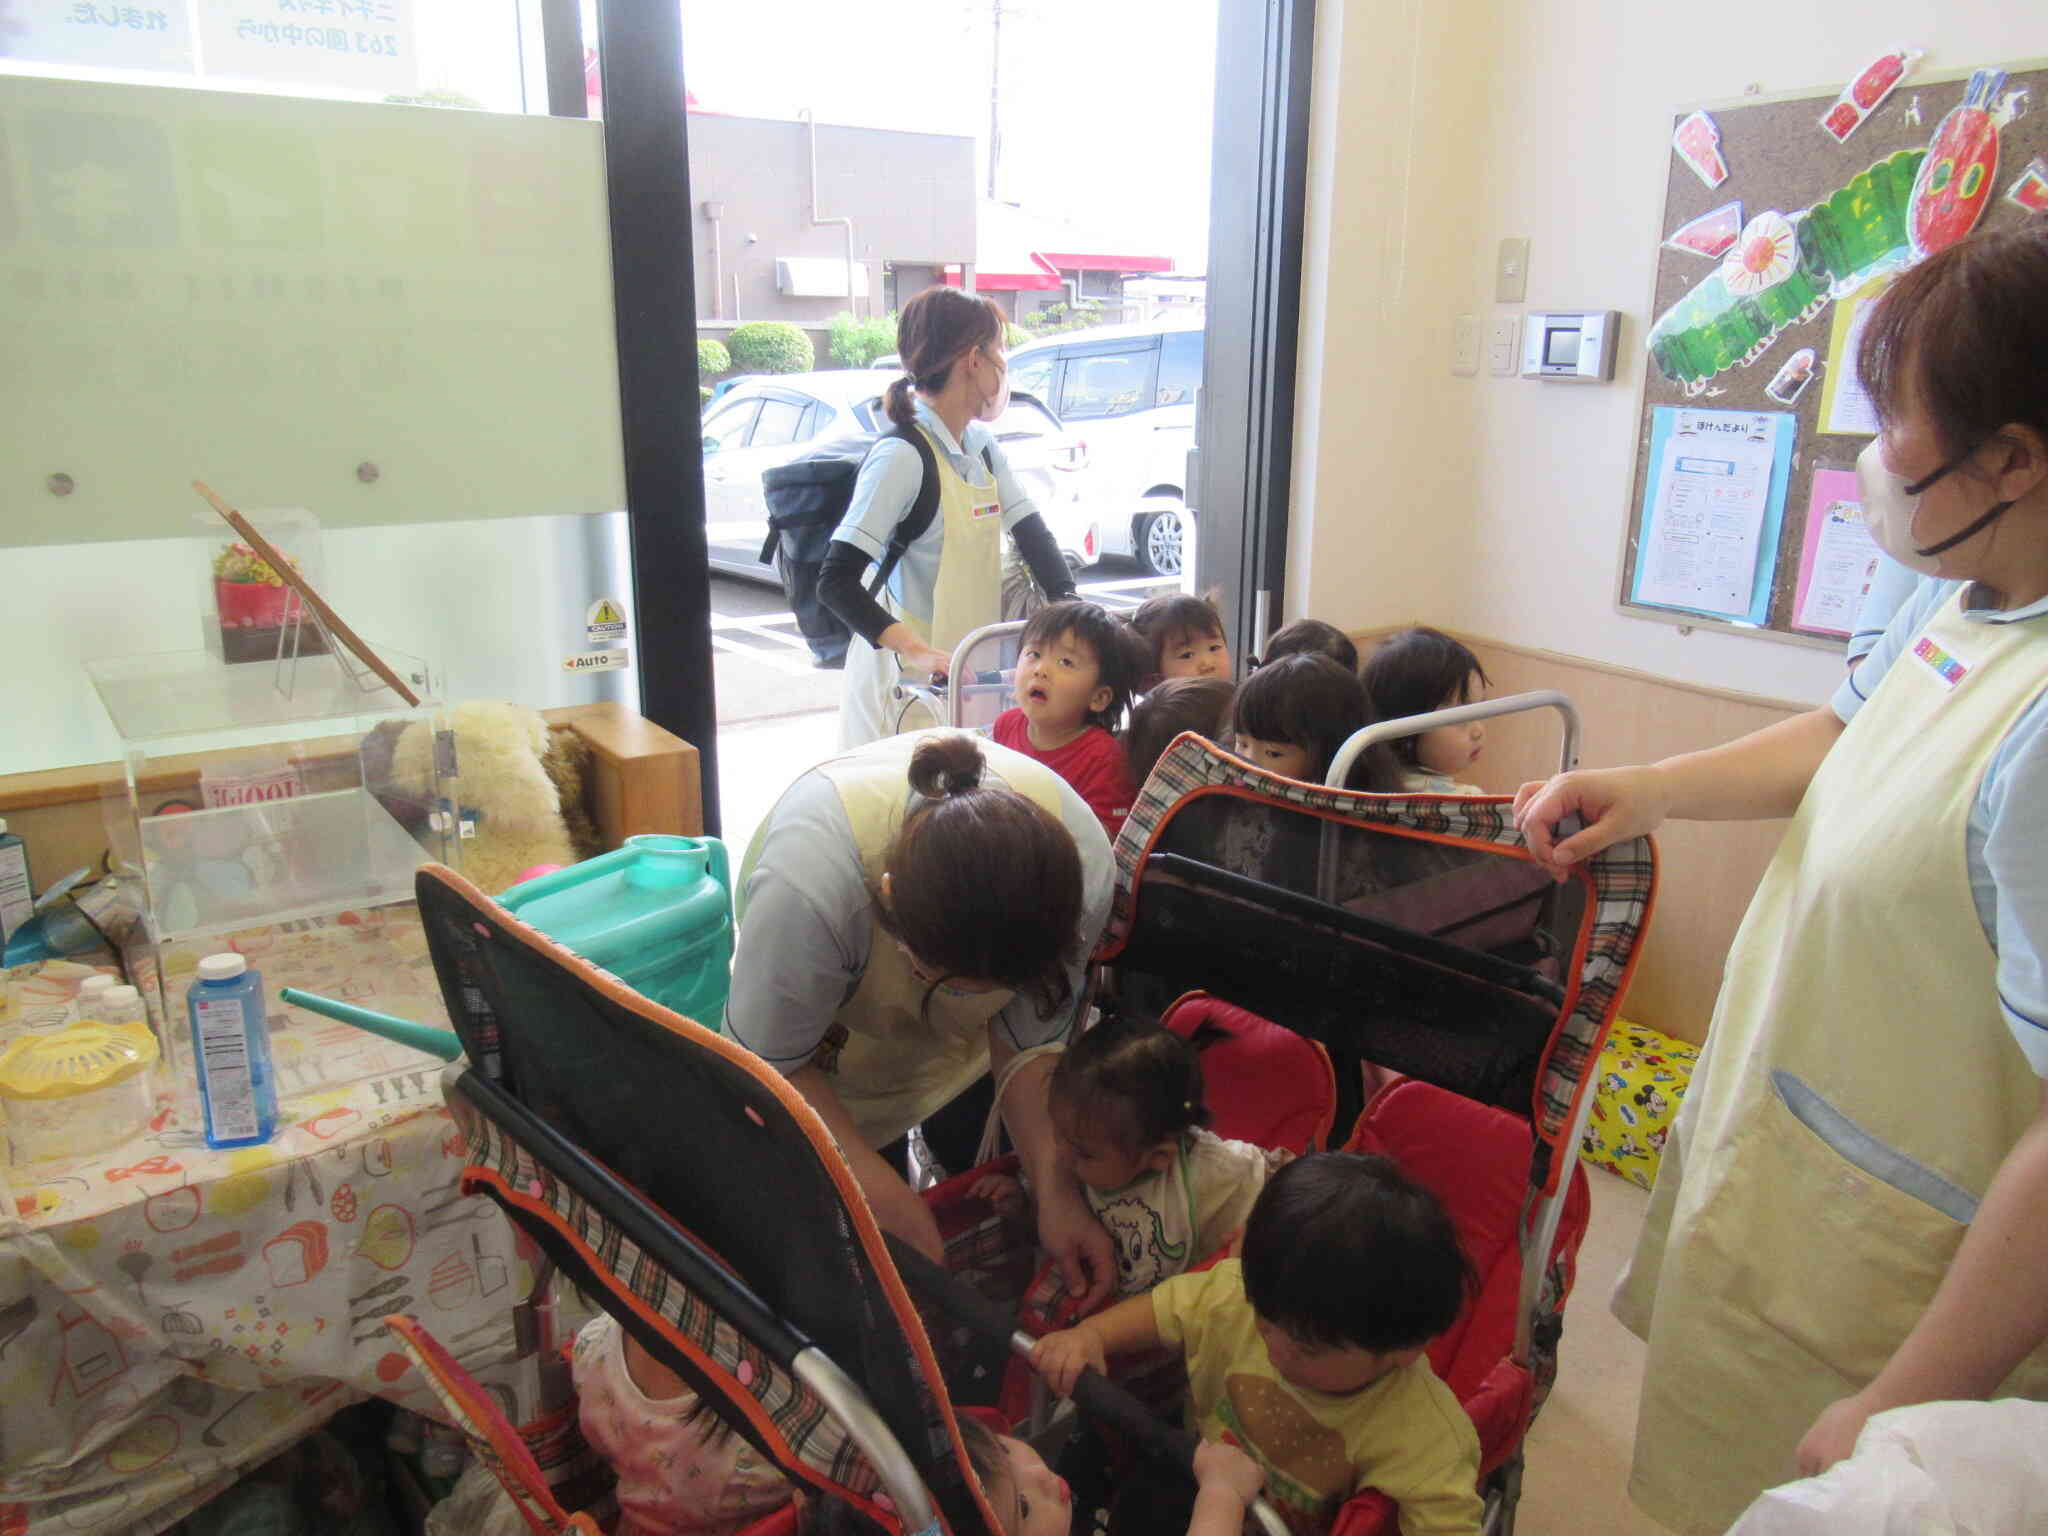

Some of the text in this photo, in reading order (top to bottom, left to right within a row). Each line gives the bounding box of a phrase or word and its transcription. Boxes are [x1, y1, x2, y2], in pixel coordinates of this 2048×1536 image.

[1696, 421, 1749, 433] ほけんだより
